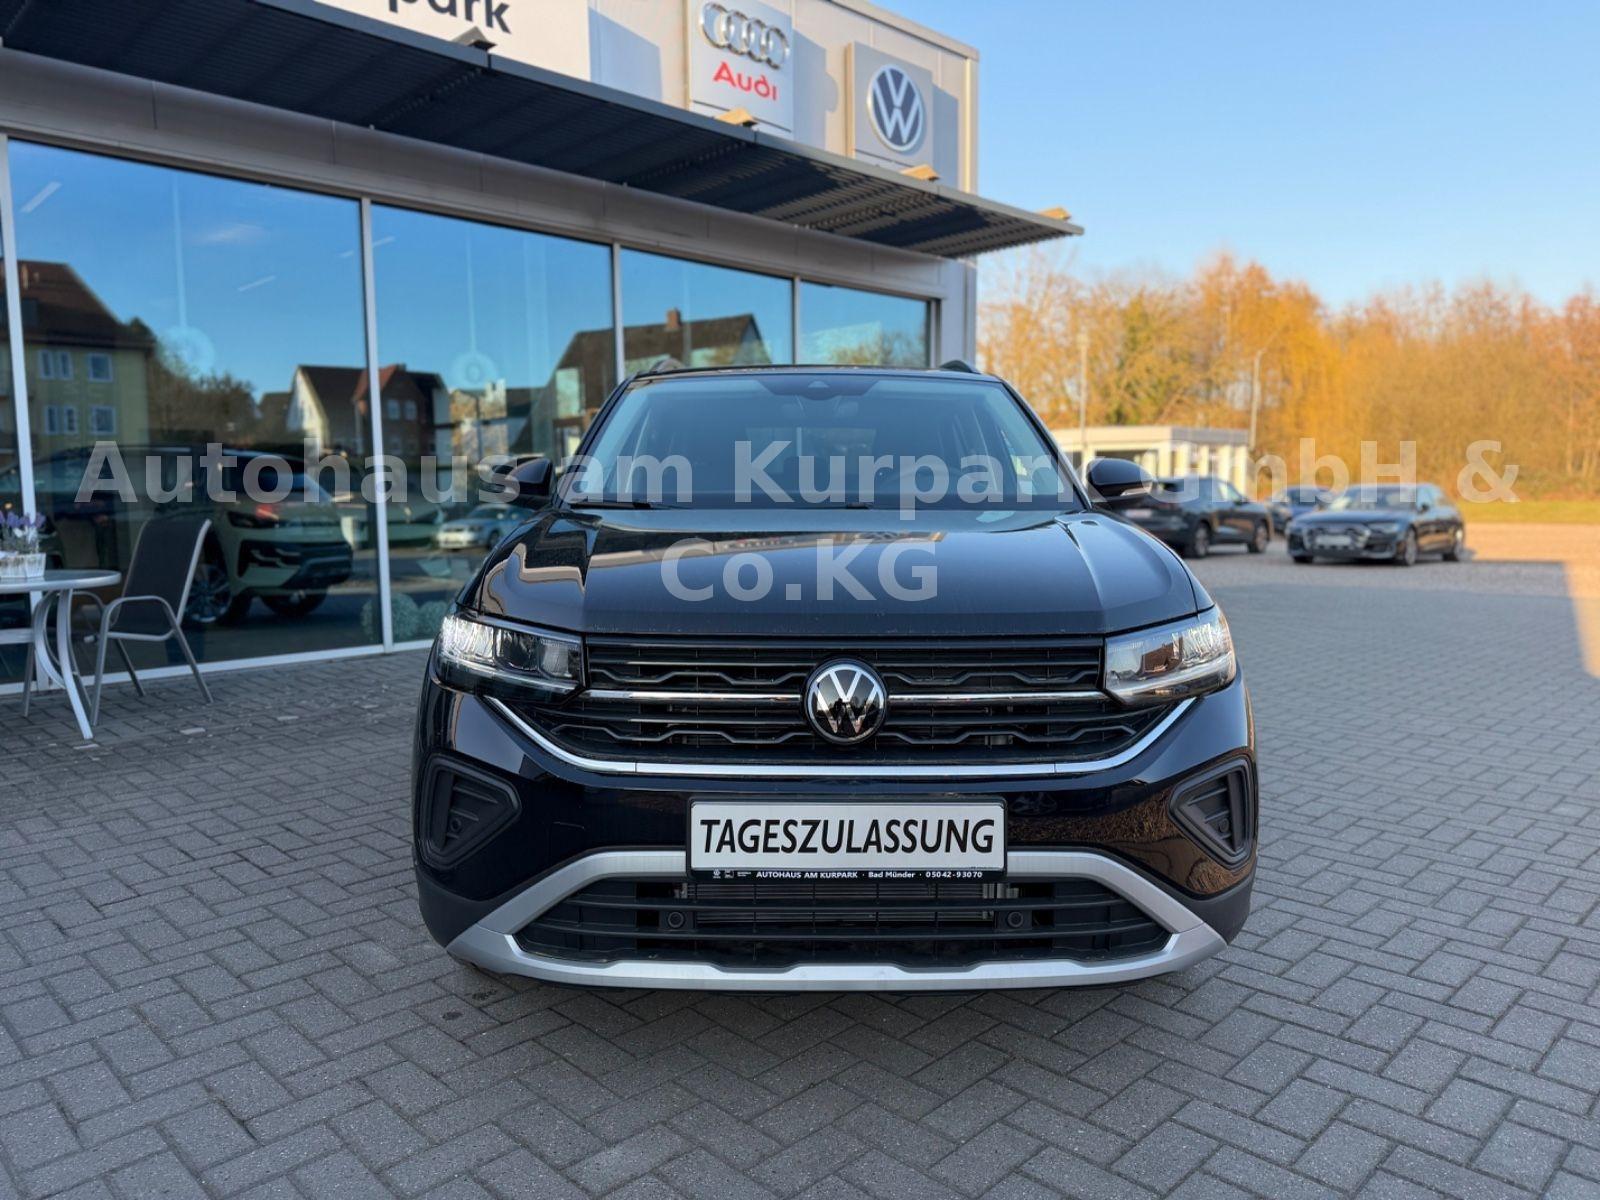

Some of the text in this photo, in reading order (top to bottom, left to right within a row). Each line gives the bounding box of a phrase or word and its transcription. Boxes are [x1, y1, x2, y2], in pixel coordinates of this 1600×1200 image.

[713, 61, 777, 101] Audi
[700, 819, 994, 854] TAGESZULASSUNG
[756, 871, 801, 879] AUTOHAUS
[804, 871, 818, 879] AM
[820, 871, 858, 879] KURPARK
[885, 870, 915, 878] Münder
